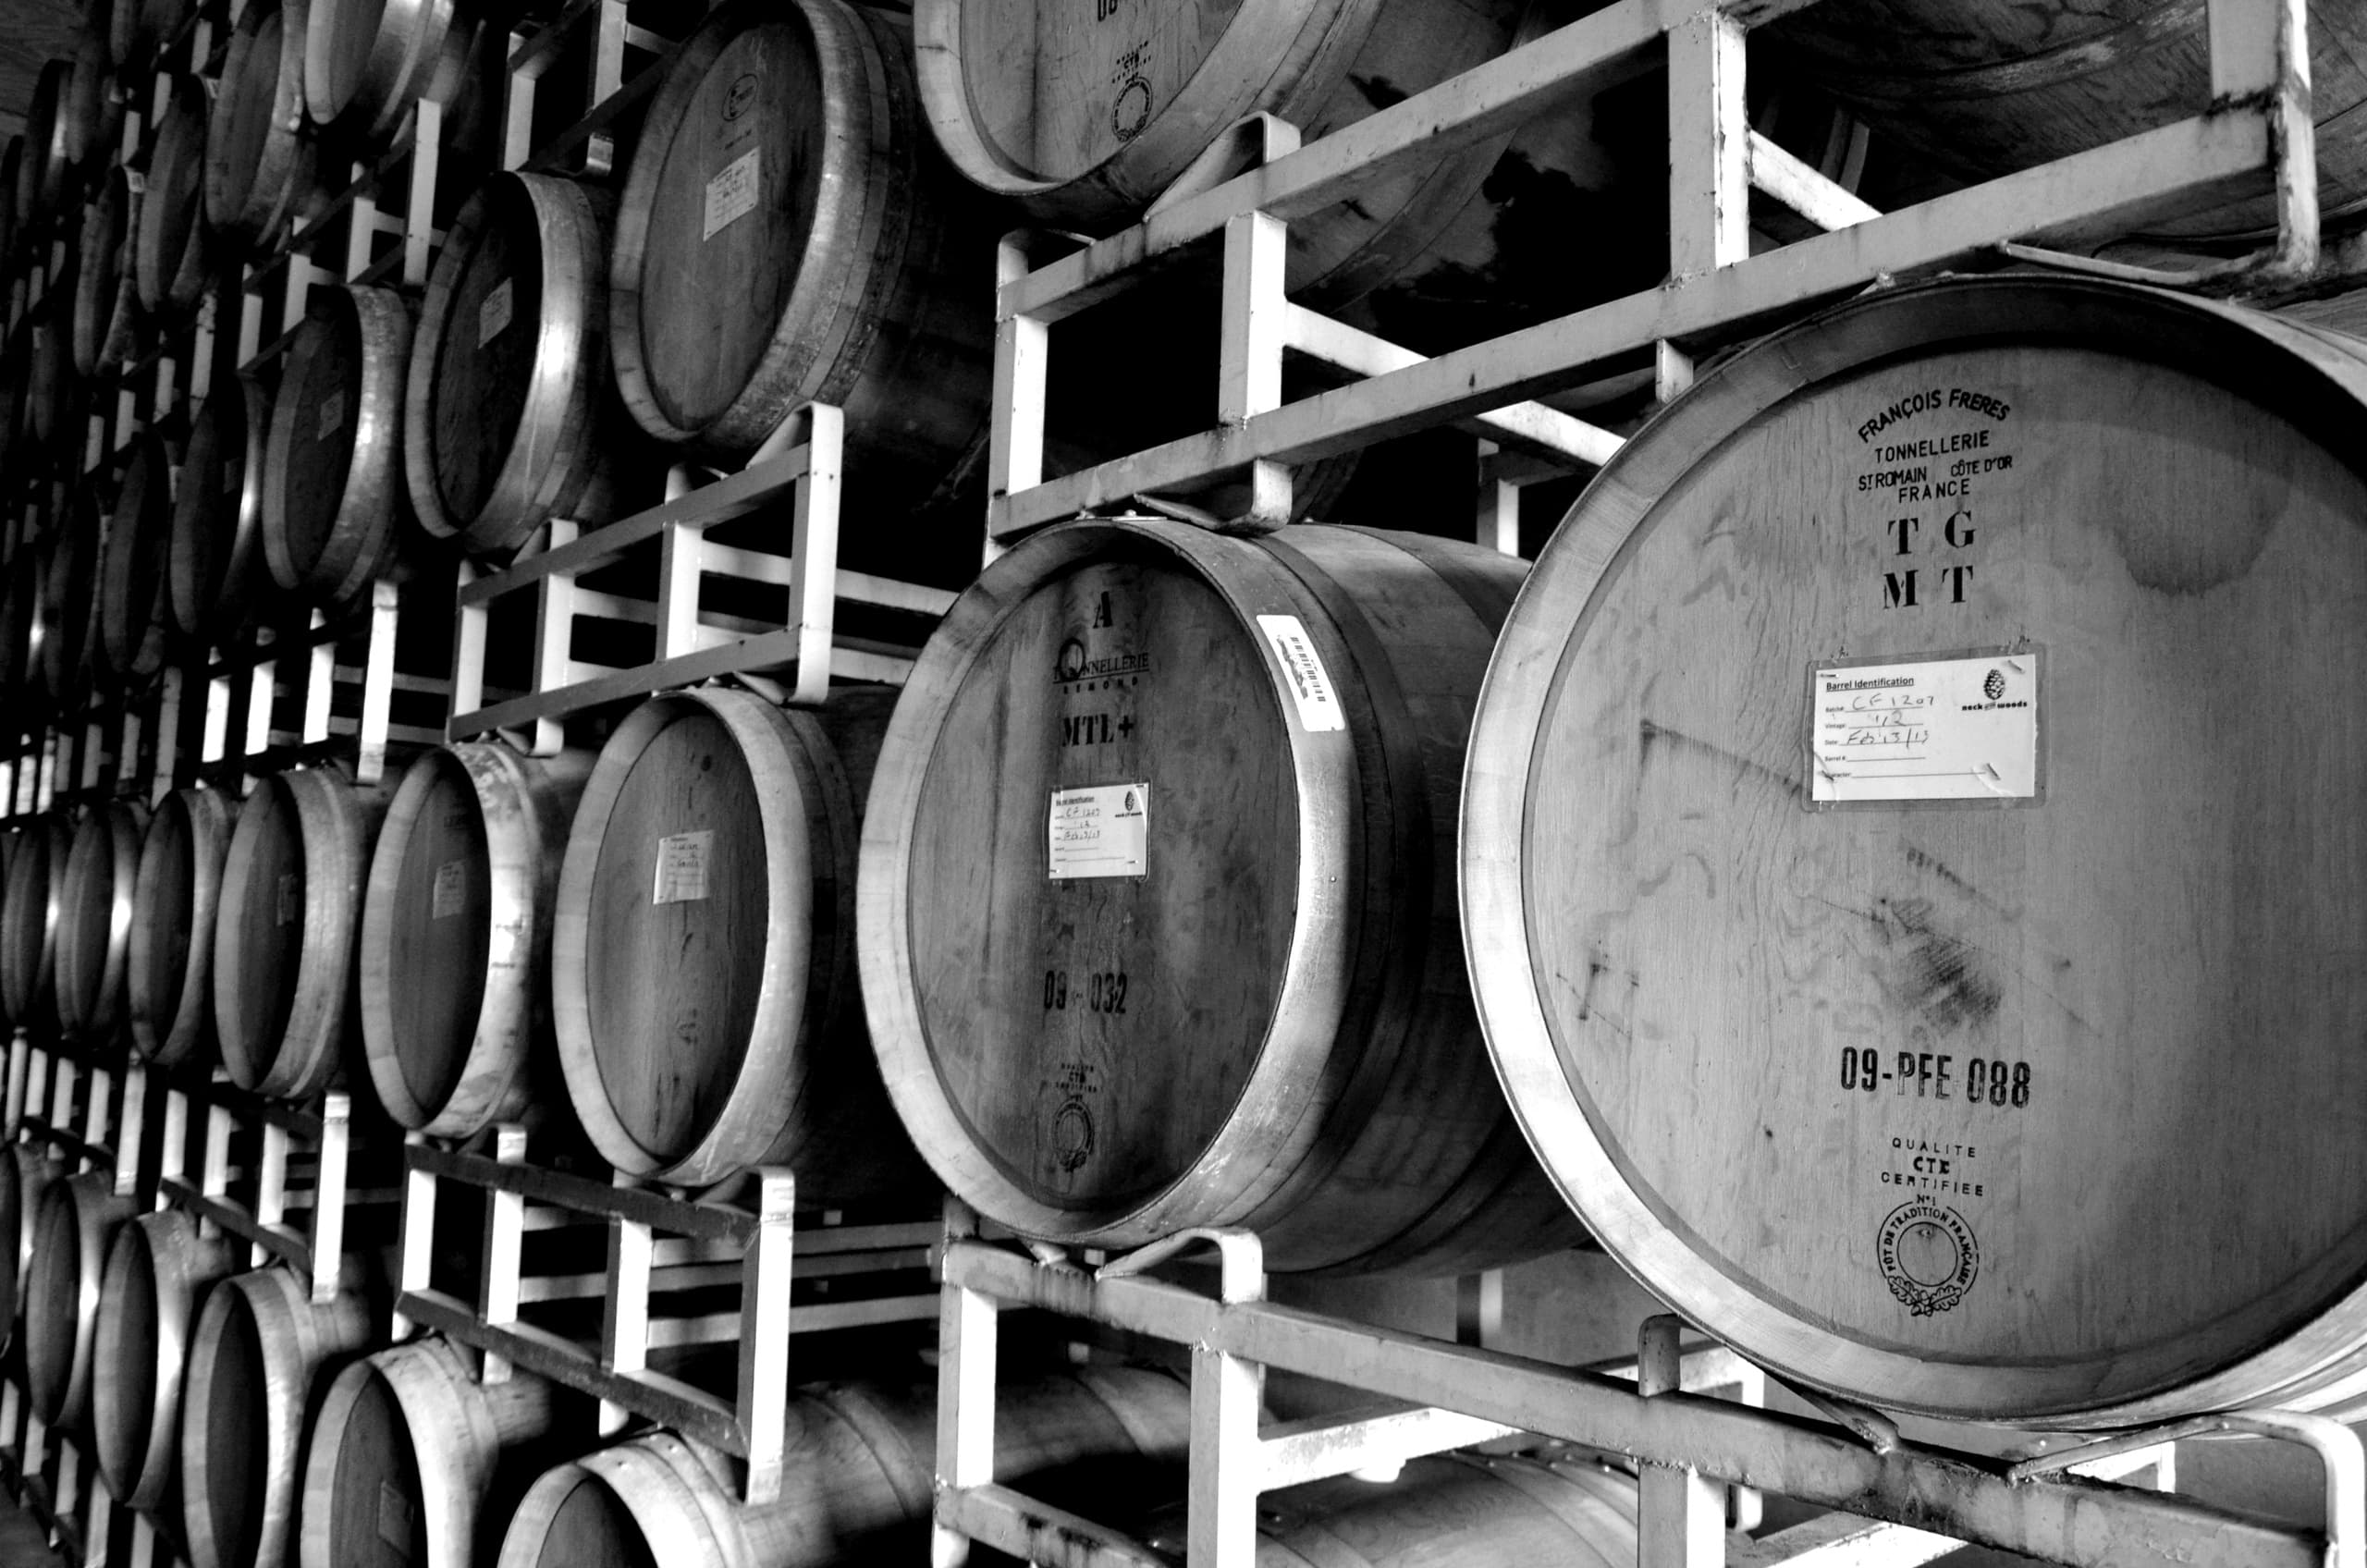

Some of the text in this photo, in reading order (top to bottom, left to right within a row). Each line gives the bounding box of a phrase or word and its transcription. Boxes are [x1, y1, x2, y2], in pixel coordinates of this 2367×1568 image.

[1858, 387, 2011, 444] FRANÇOIS FRERES
[1874, 430, 1990, 464] TONNELLERIE
[1898, 478, 1970, 504] FRANCE
[1887, 510, 1977, 556] T G
[1883, 565, 1974, 610] M T
[1826, 676, 1915, 692] Barrel Identification
[1967, 1057, 2031, 1109] 088
[1892, 1137, 1976, 1158] QUALITE
[1881, 1171, 1983, 1196] CERTIFIEE
[1890, 1206, 1950, 1230] TRADITION
